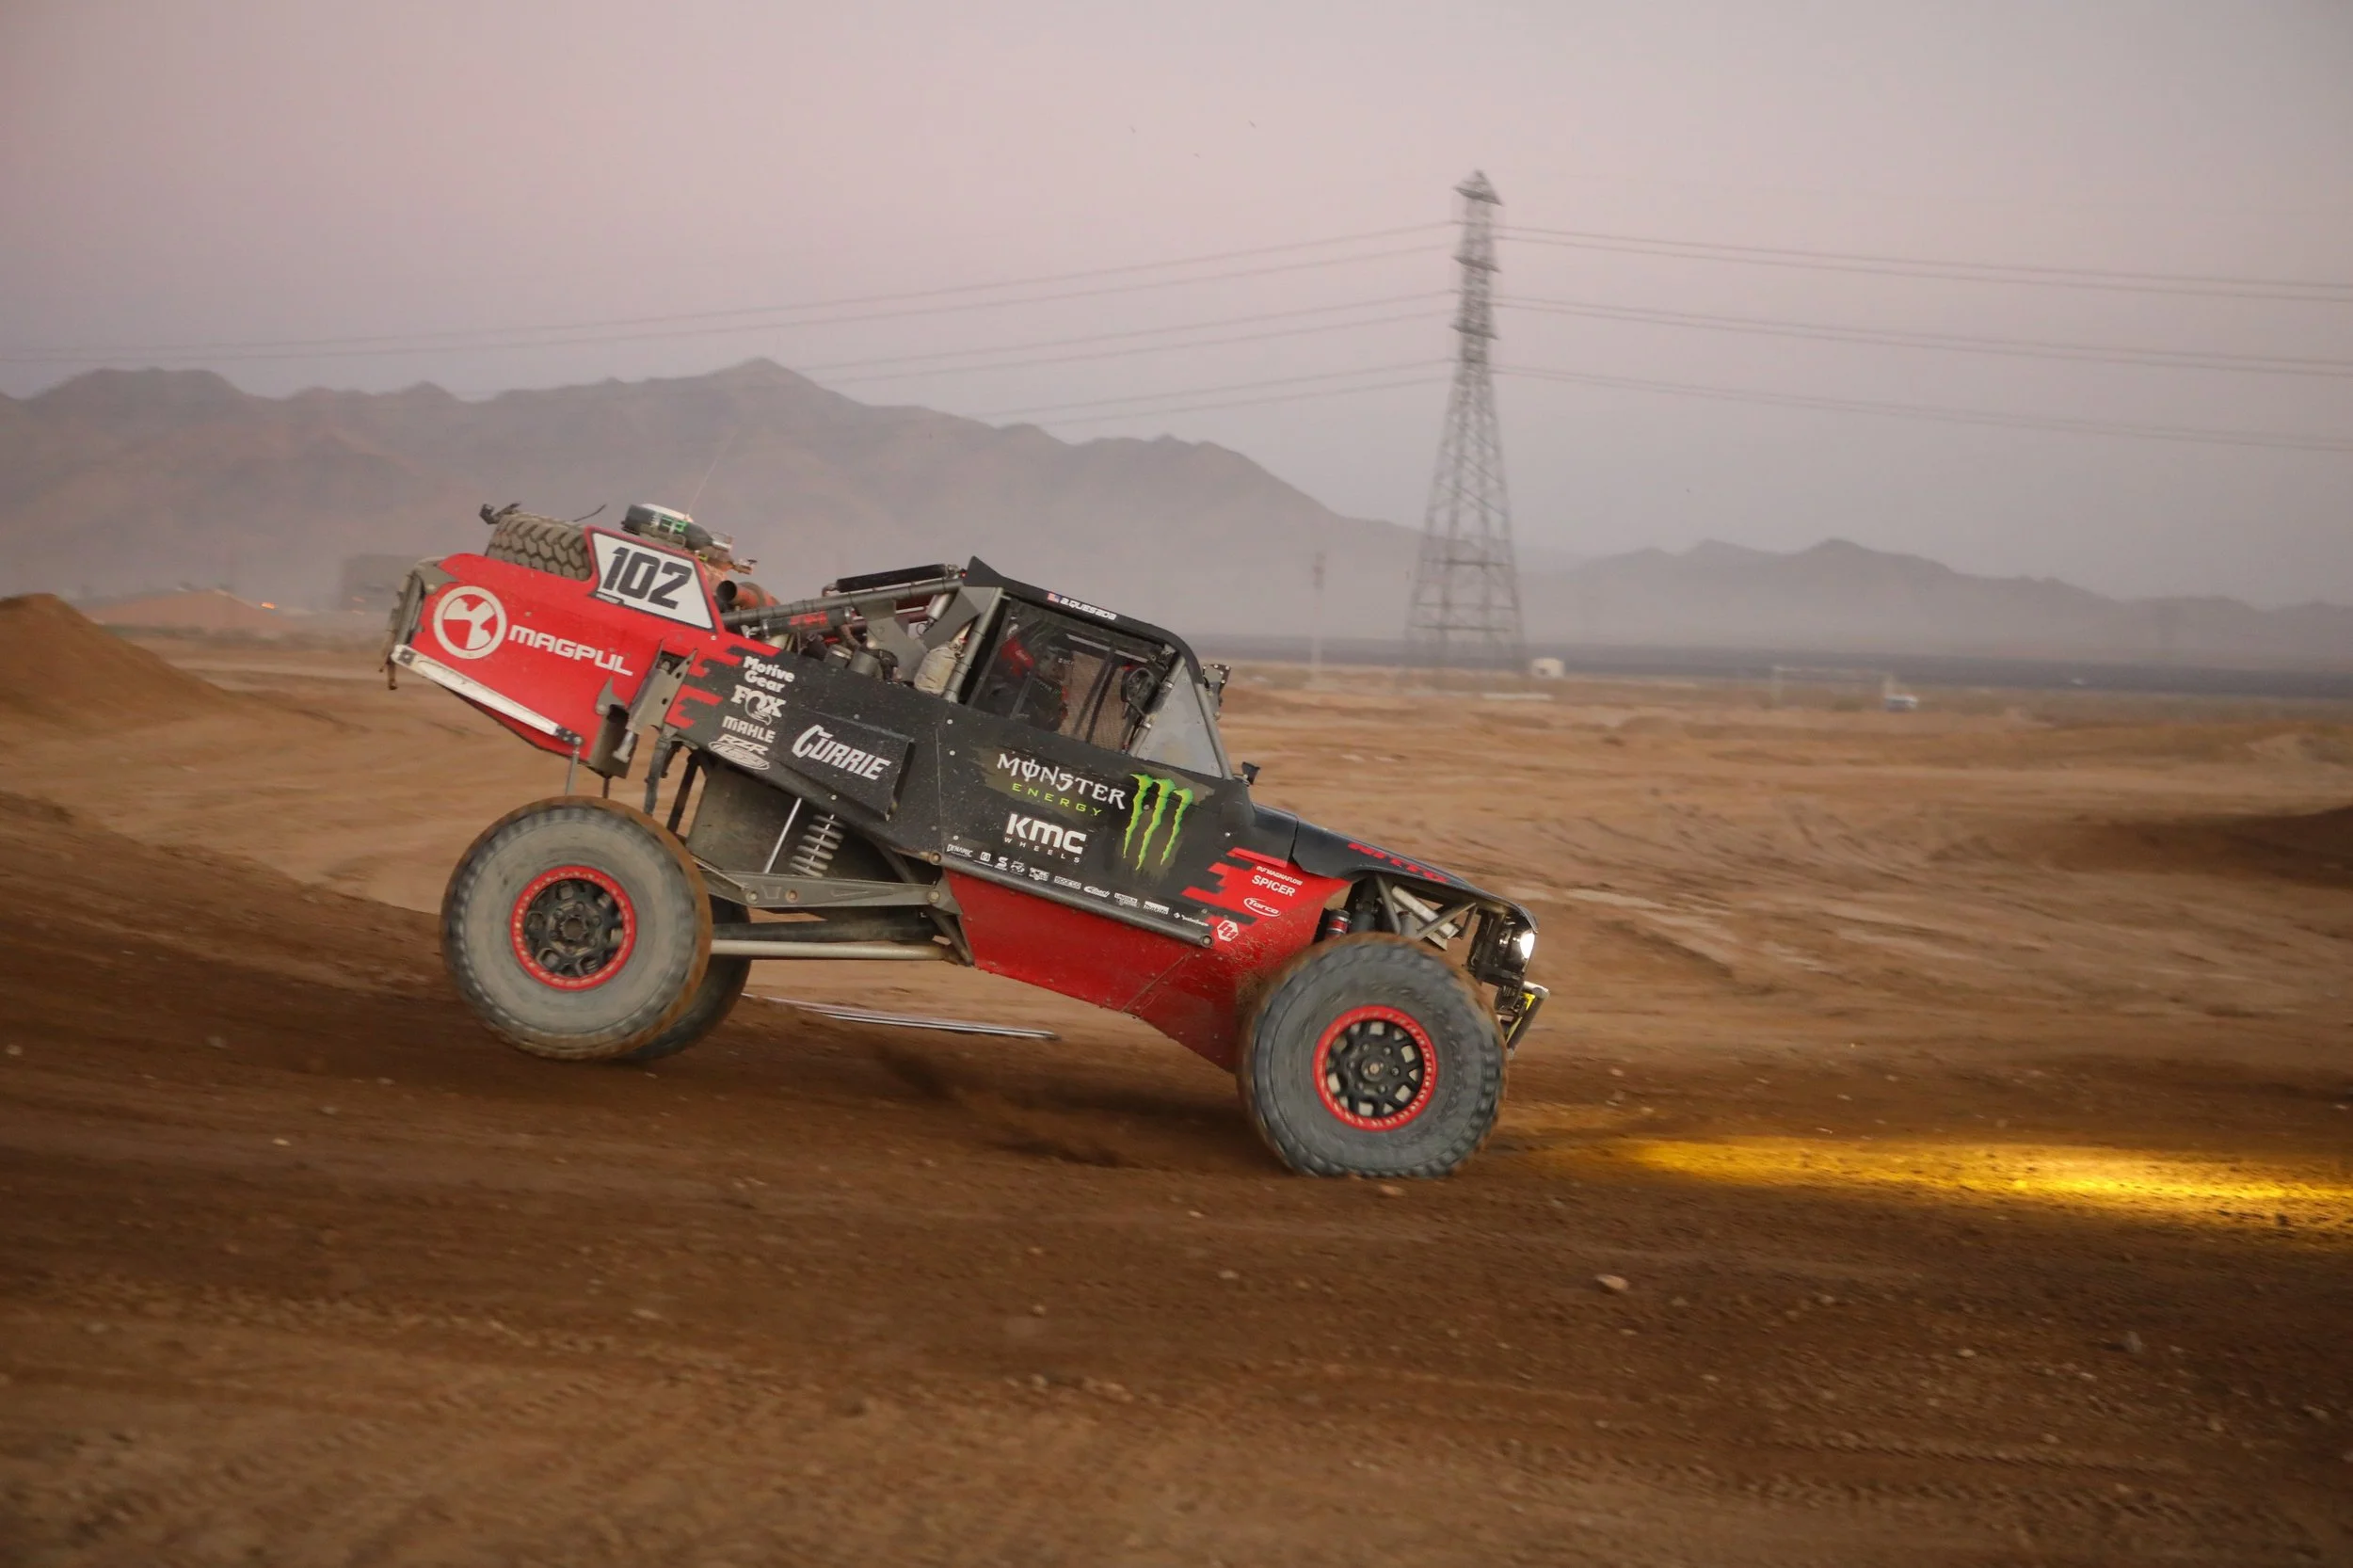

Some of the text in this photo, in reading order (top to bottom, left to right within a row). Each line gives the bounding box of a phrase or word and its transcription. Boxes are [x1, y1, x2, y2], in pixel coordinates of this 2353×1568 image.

[602, 546, 693, 610] 102
[508, 624, 633, 677] MAGPUL
[743, 656, 795, 682] Motive
[744, 669, 785, 693] Gear
[730, 684, 786, 722] FOX
[716, 733, 769, 756] RZR
[722, 715, 776, 744] MAHLE
[792, 724, 892, 780] CURRIE
[997, 753, 1126, 809] MONSTER
[1012, 782, 1102, 817] ENERGY
[1003, 837, 1080, 863] WHEELS
[1006, 813, 1088, 855] KMC
[1252, 874, 1296, 897] SPICER
